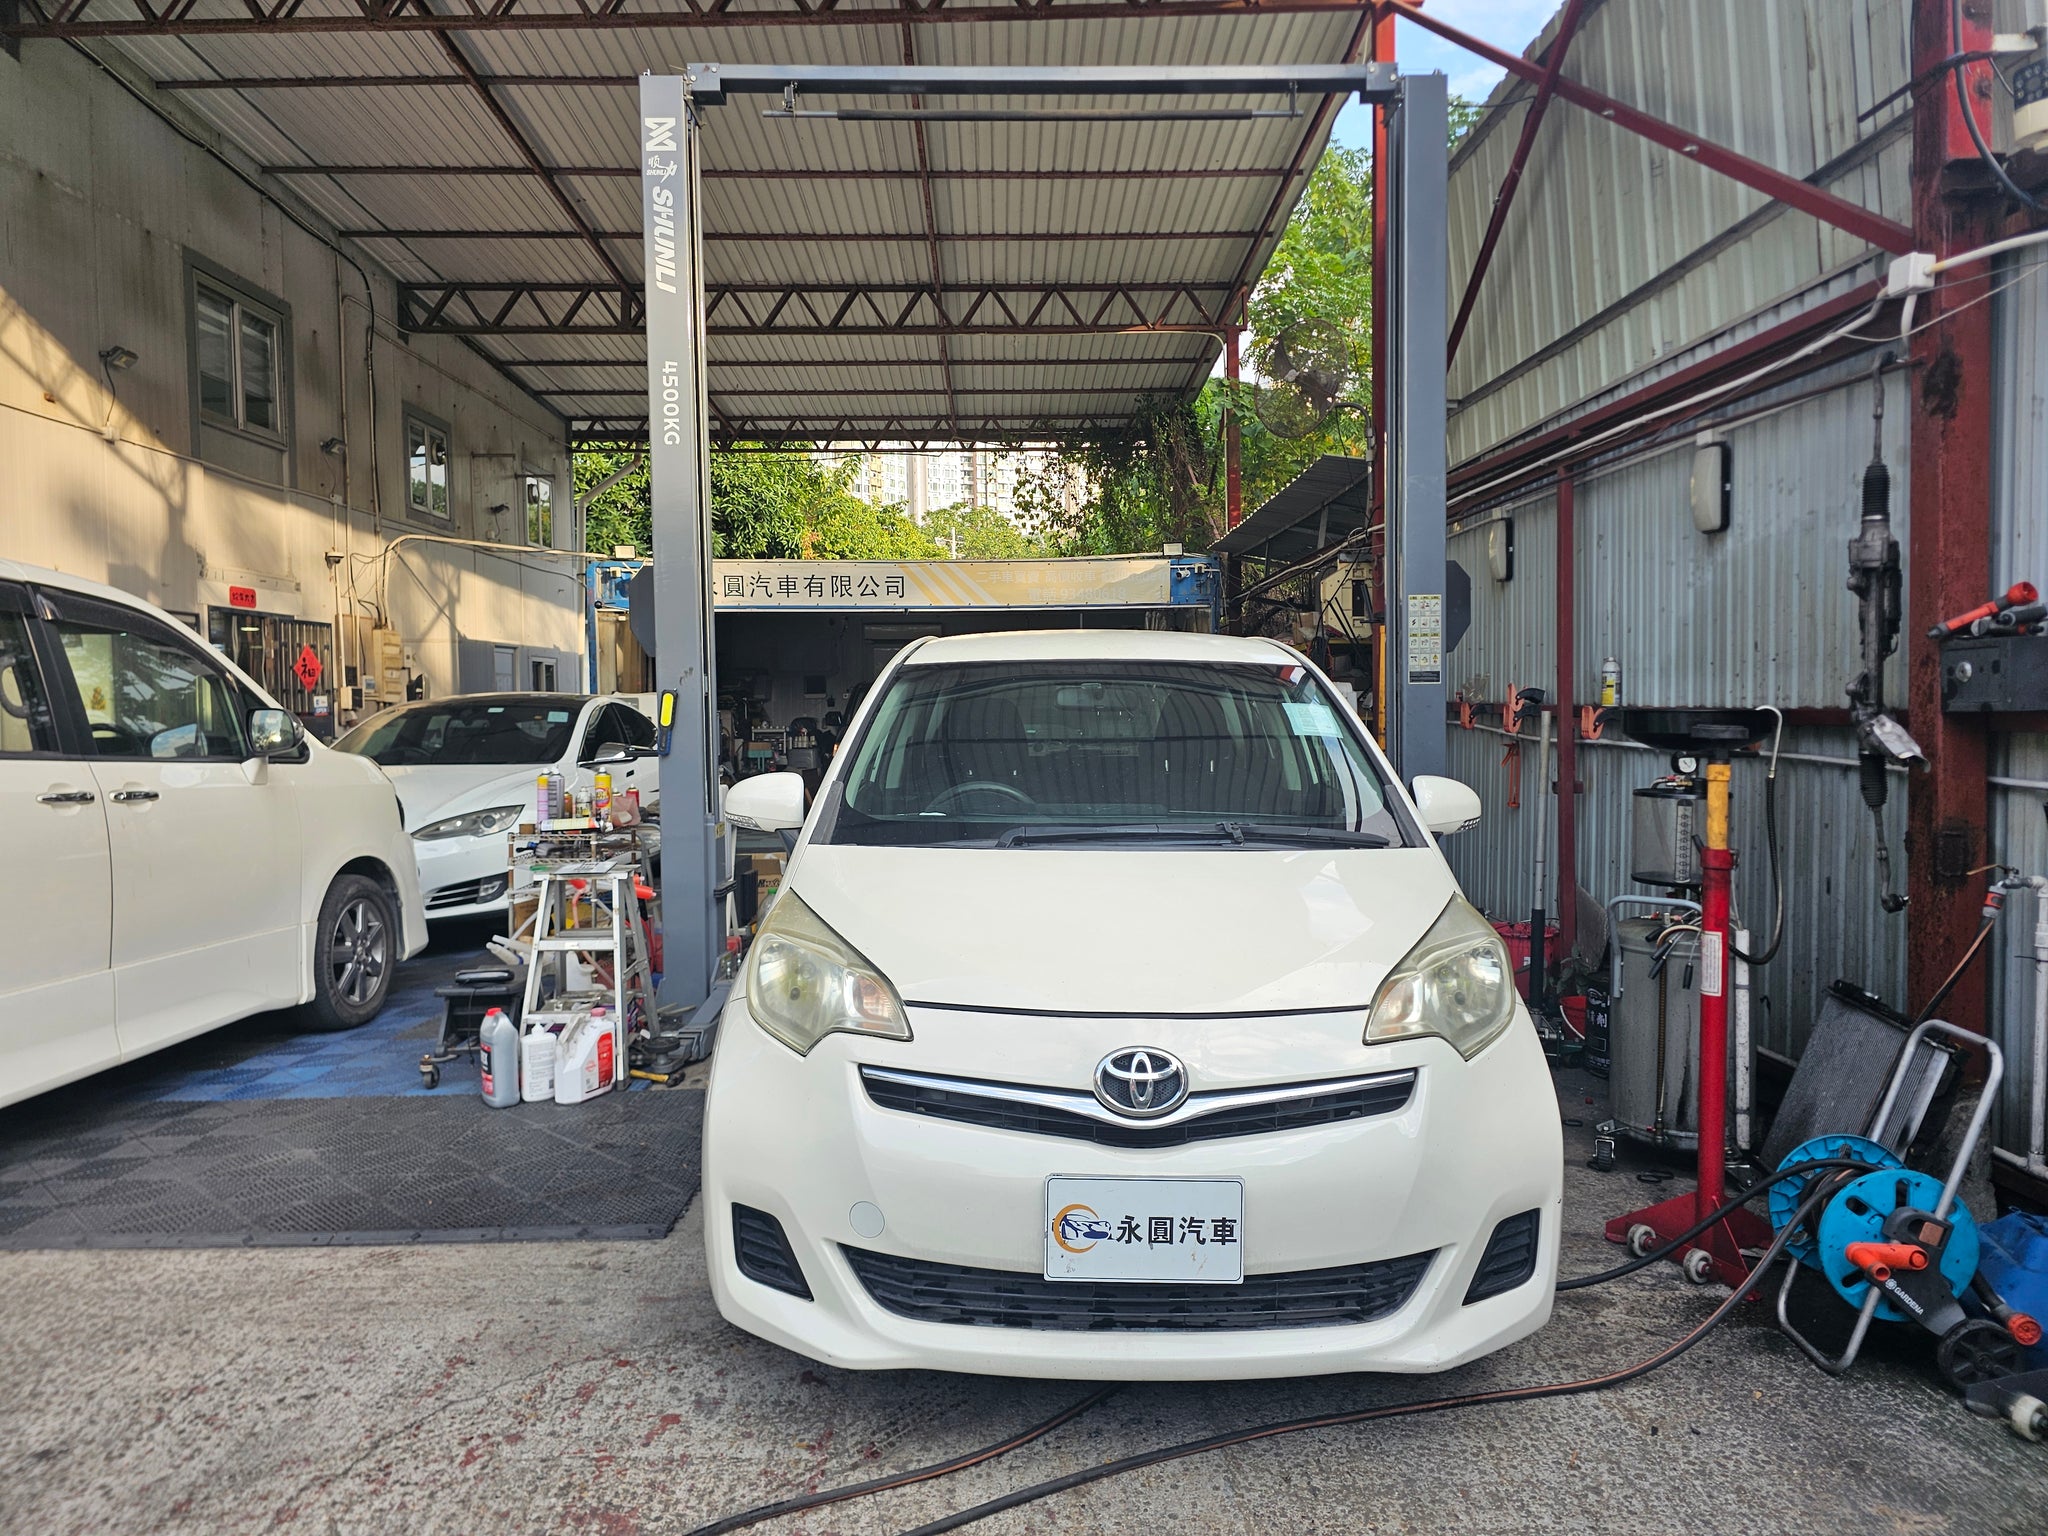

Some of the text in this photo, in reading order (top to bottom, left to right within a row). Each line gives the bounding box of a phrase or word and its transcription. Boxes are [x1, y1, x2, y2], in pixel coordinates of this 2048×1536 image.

[652, 186, 677, 294] SHUNLI
[662, 360, 681, 446] 4500KG
[713, 574, 905, 598] 圓汽車有限公司
[1116, 1215, 1238, 1245] 永圓汽車
[1894, 1287, 1924, 1315] GARDENA
